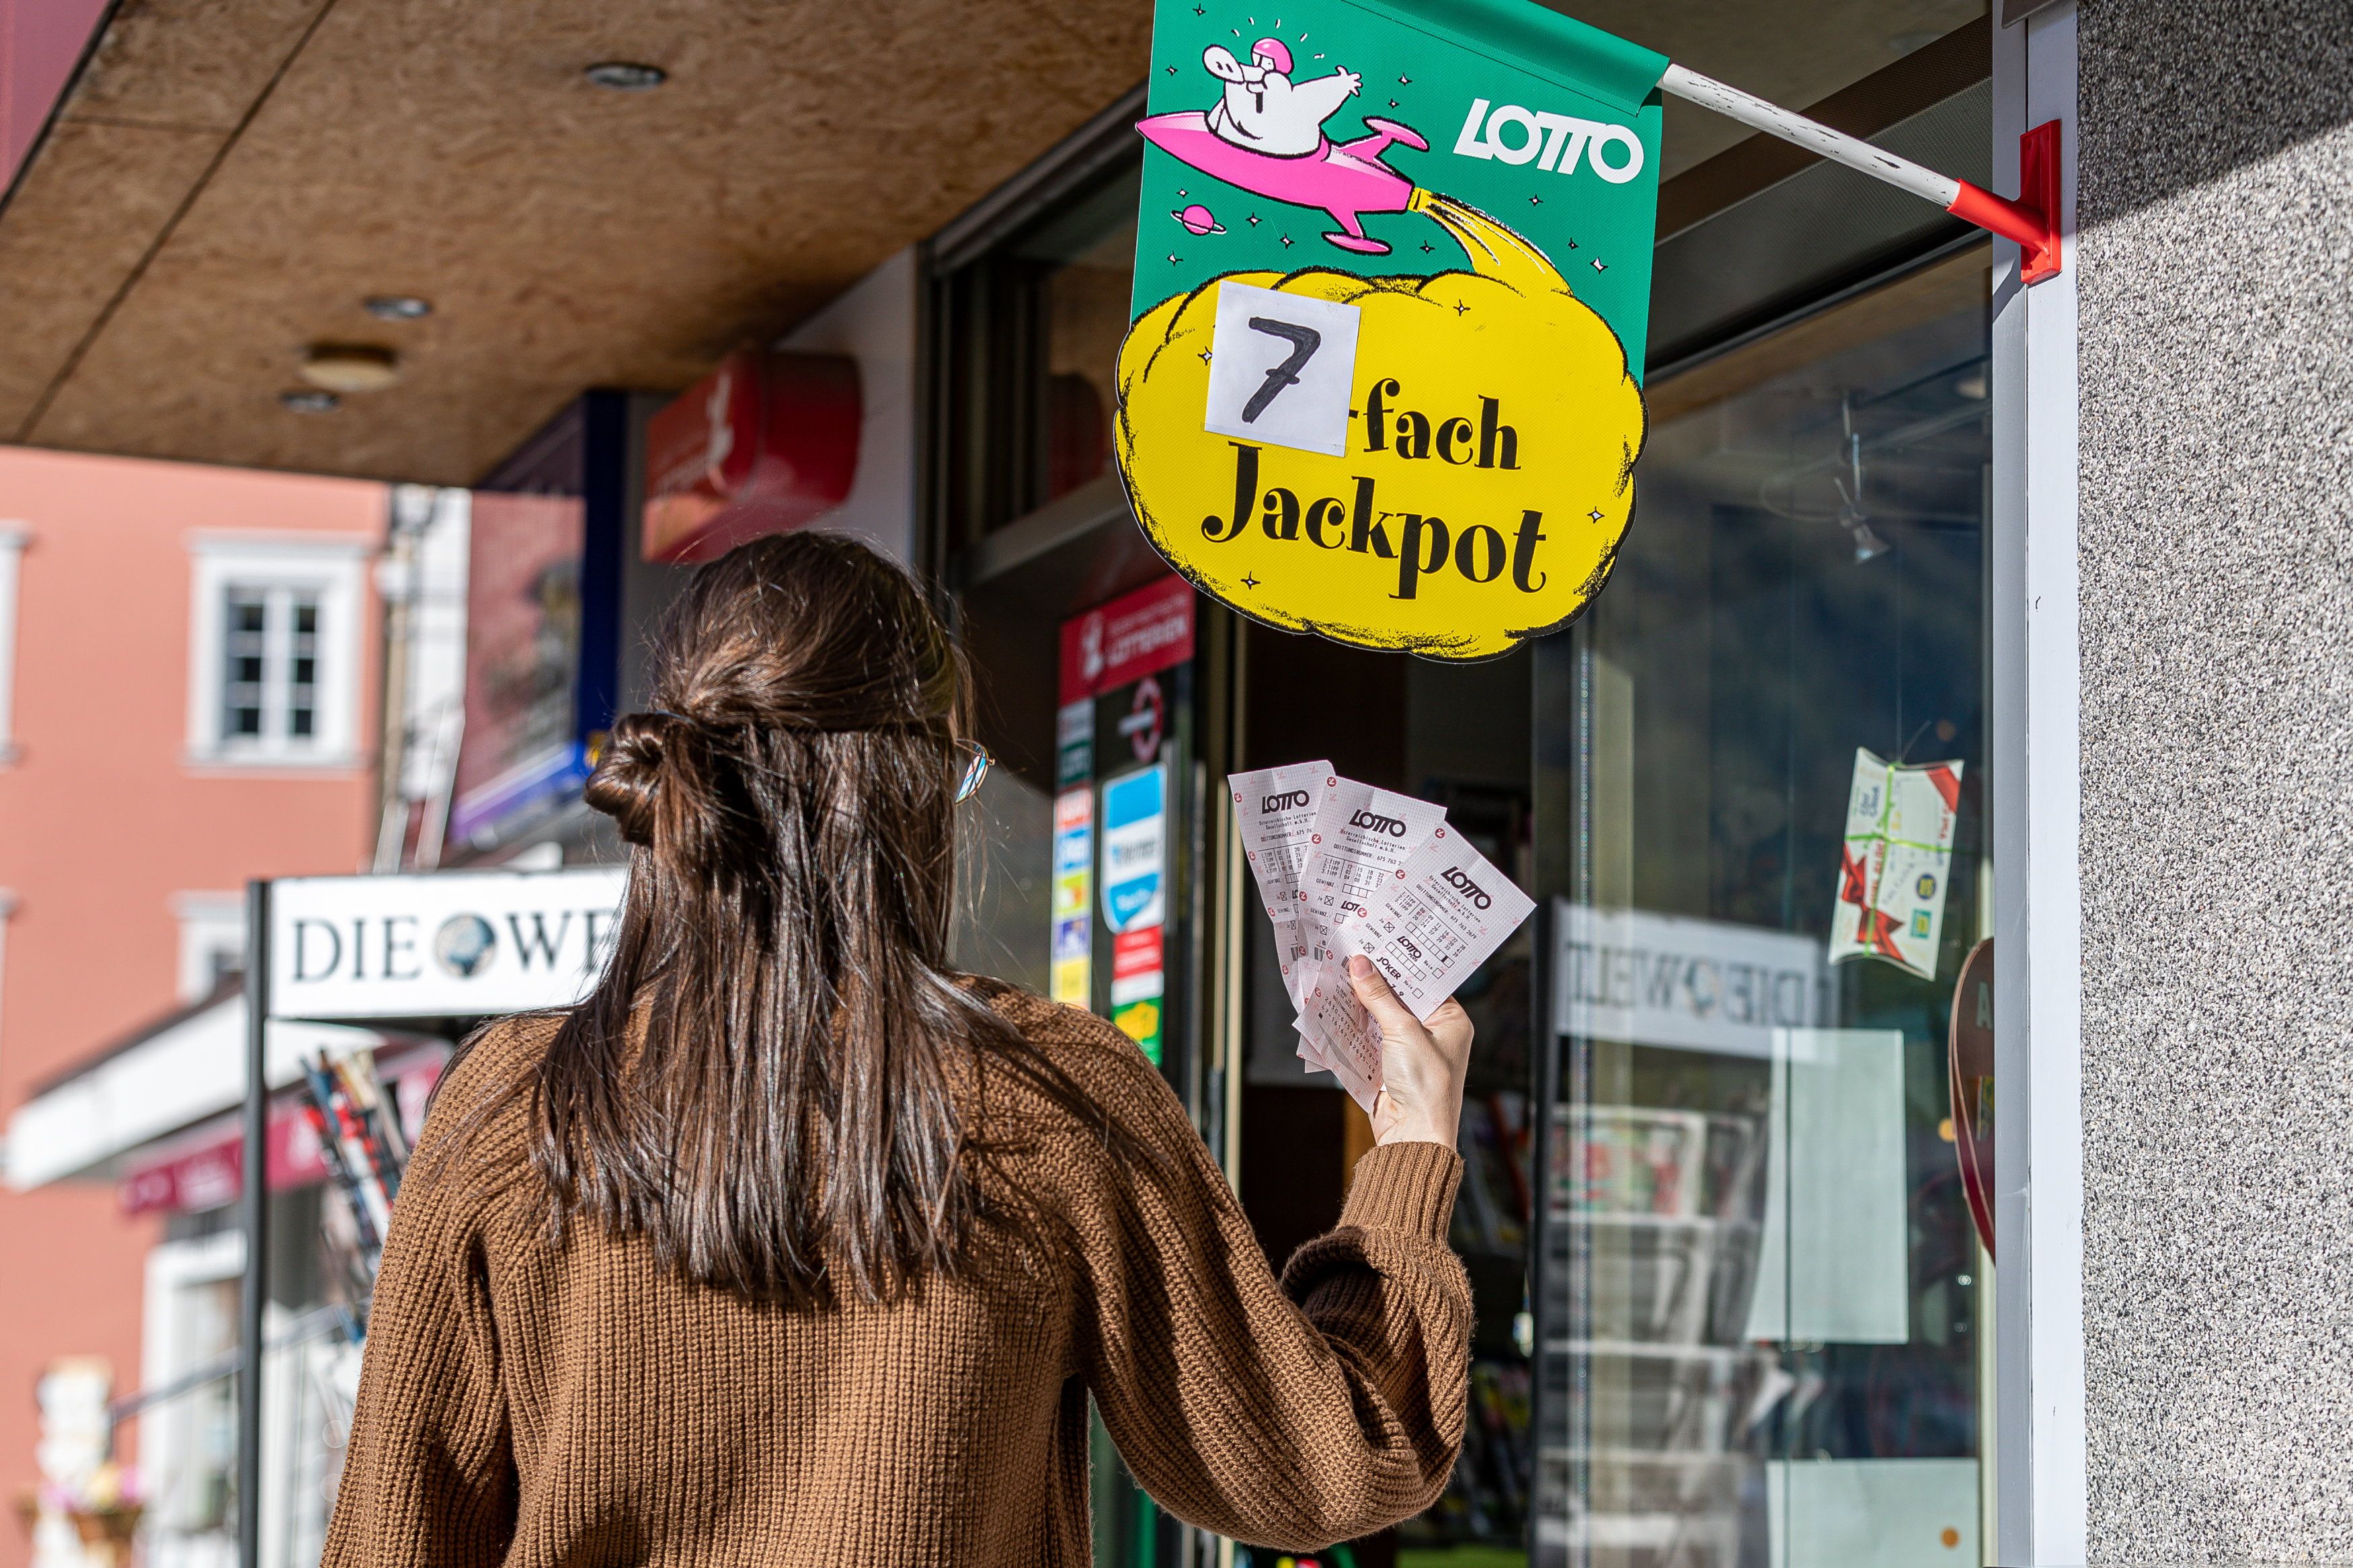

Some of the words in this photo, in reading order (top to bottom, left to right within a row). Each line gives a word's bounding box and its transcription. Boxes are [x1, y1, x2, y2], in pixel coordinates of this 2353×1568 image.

[1453, 98, 1644, 183] LOTTO
[1241, 317, 1321, 423] 7
[1201, 441, 1547, 600] Jackpot
[1262, 790, 1309, 814] LOTTO
[1349, 809, 1406, 837] LOTTO
[1346, 836, 1377, 848] Gesellschaft
[1381, 839, 1405, 850] Lotterien
[1321, 868, 1337, 876] 3.TIPP
[1323, 863, 1339, 871] 2.TIPP
[1324, 858, 1341, 866] 1.TIPP
[1316, 878, 1338, 888] GEWINNZ.:
[1441, 867, 1491, 909] LOTTO
[1394, 898, 1408, 911] 3.TIPP
[1398, 895, 1412, 907] 2.TIPP
[1402, 891, 1416, 903] 1.TIPP
[1431, 884, 1457, 908] Gesellschaft
[1386, 903, 1403, 921] GEWINNZ.:
[1417, 884, 1450, 915] QUITTUNGSNUMMER:
[1466, 930, 1476, 939] 2679
[1461, 904, 1480, 923] Lotterien
[1365, 923, 1384, 941] GEWINNZ.:
[292, 915, 423, 983] DIE
[1397, 936, 1421, 958] LOTTO
[1423, 960, 1433, 970] Nein
[1408, 953, 1418, 962] PLUS
[1376, 957, 1401, 980] JOKER
[1404, 980, 1412, 989] Nein
[1321, 1005, 1375, 1073] 47-16167-62695-48
[1325, 997, 1378, 1065] 2830-6757632679-3
